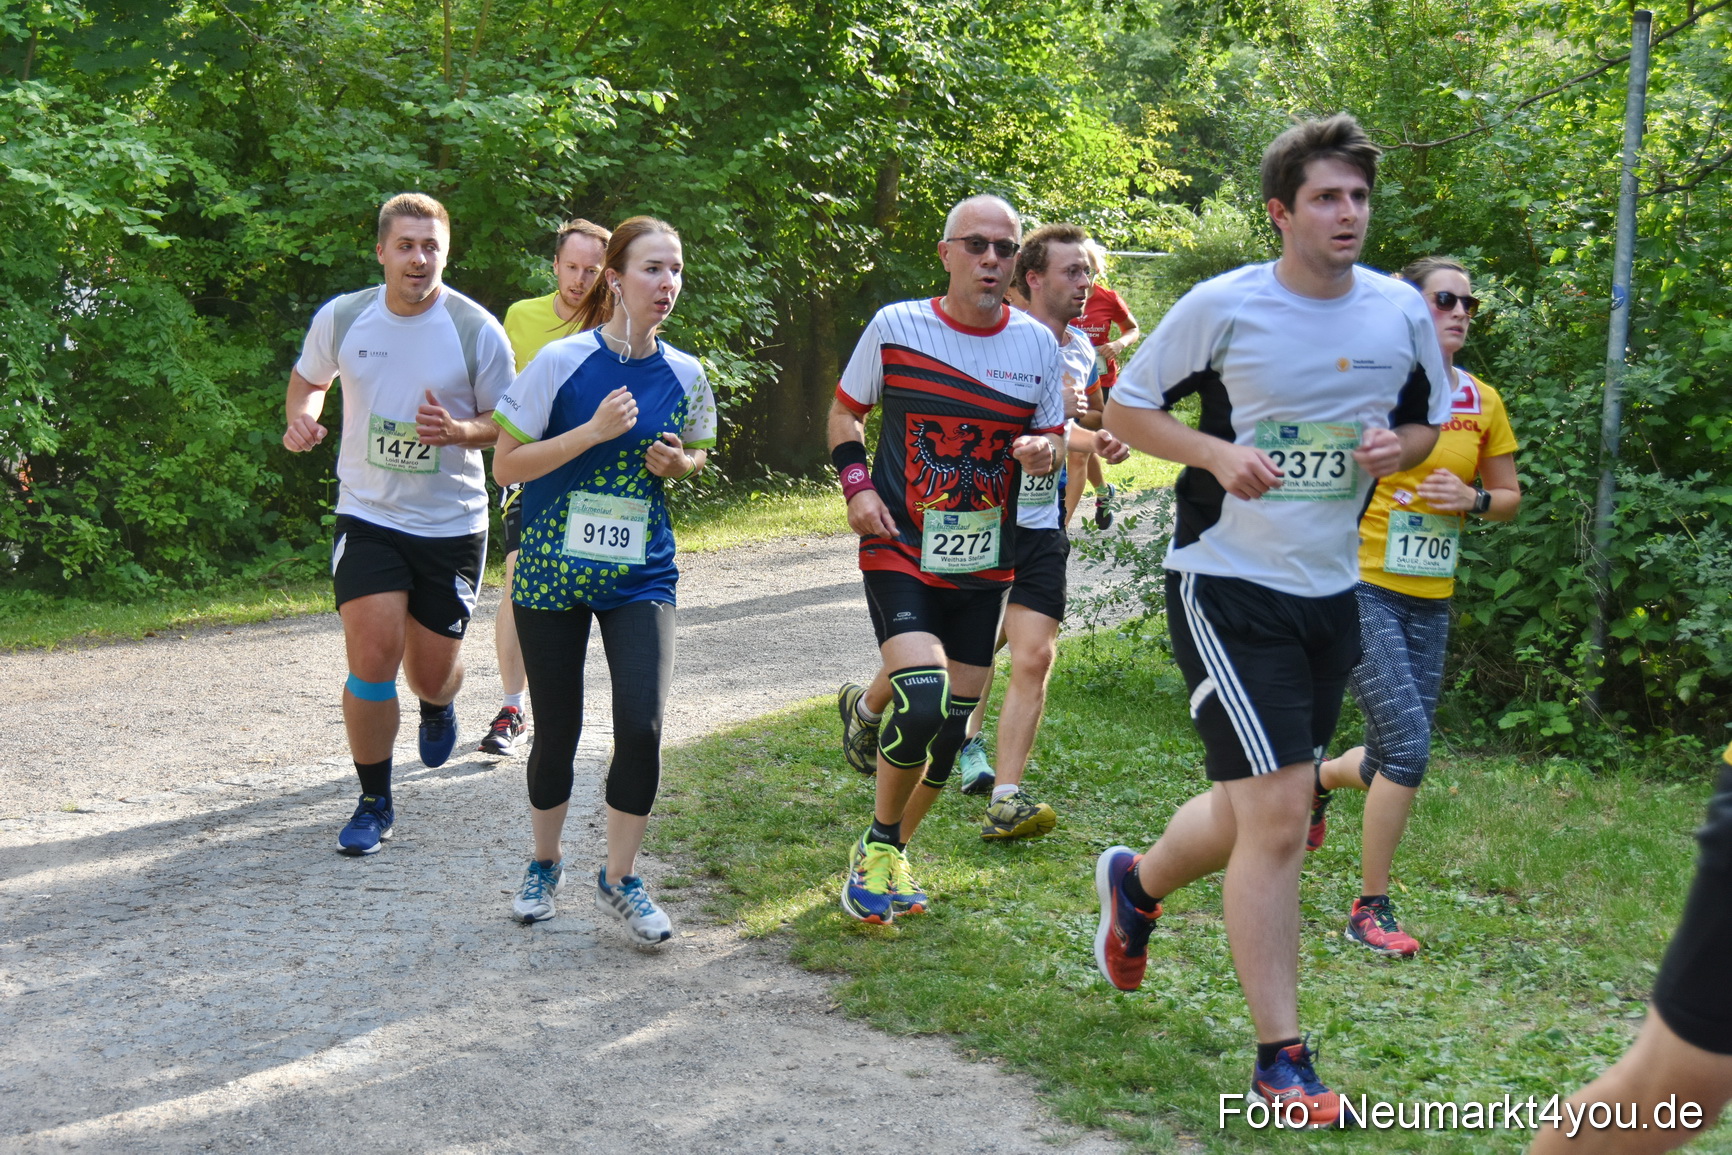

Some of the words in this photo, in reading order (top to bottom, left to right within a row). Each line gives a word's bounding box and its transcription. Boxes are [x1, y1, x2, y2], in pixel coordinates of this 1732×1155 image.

[986, 368, 1034, 383] NEUMARKT
[376, 436, 431, 460] 1472
[1267, 450, 1346, 479] 2373
[1023, 473, 1055, 492] 328
[1302, 479, 1333, 488] Michael
[583, 522, 631, 549] 9139
[931, 530, 992, 556] 2272
[1398, 534, 1452, 560] 1706
[940, 555, 967, 563] Weithas
[968, 554, 986, 562] Stefan
